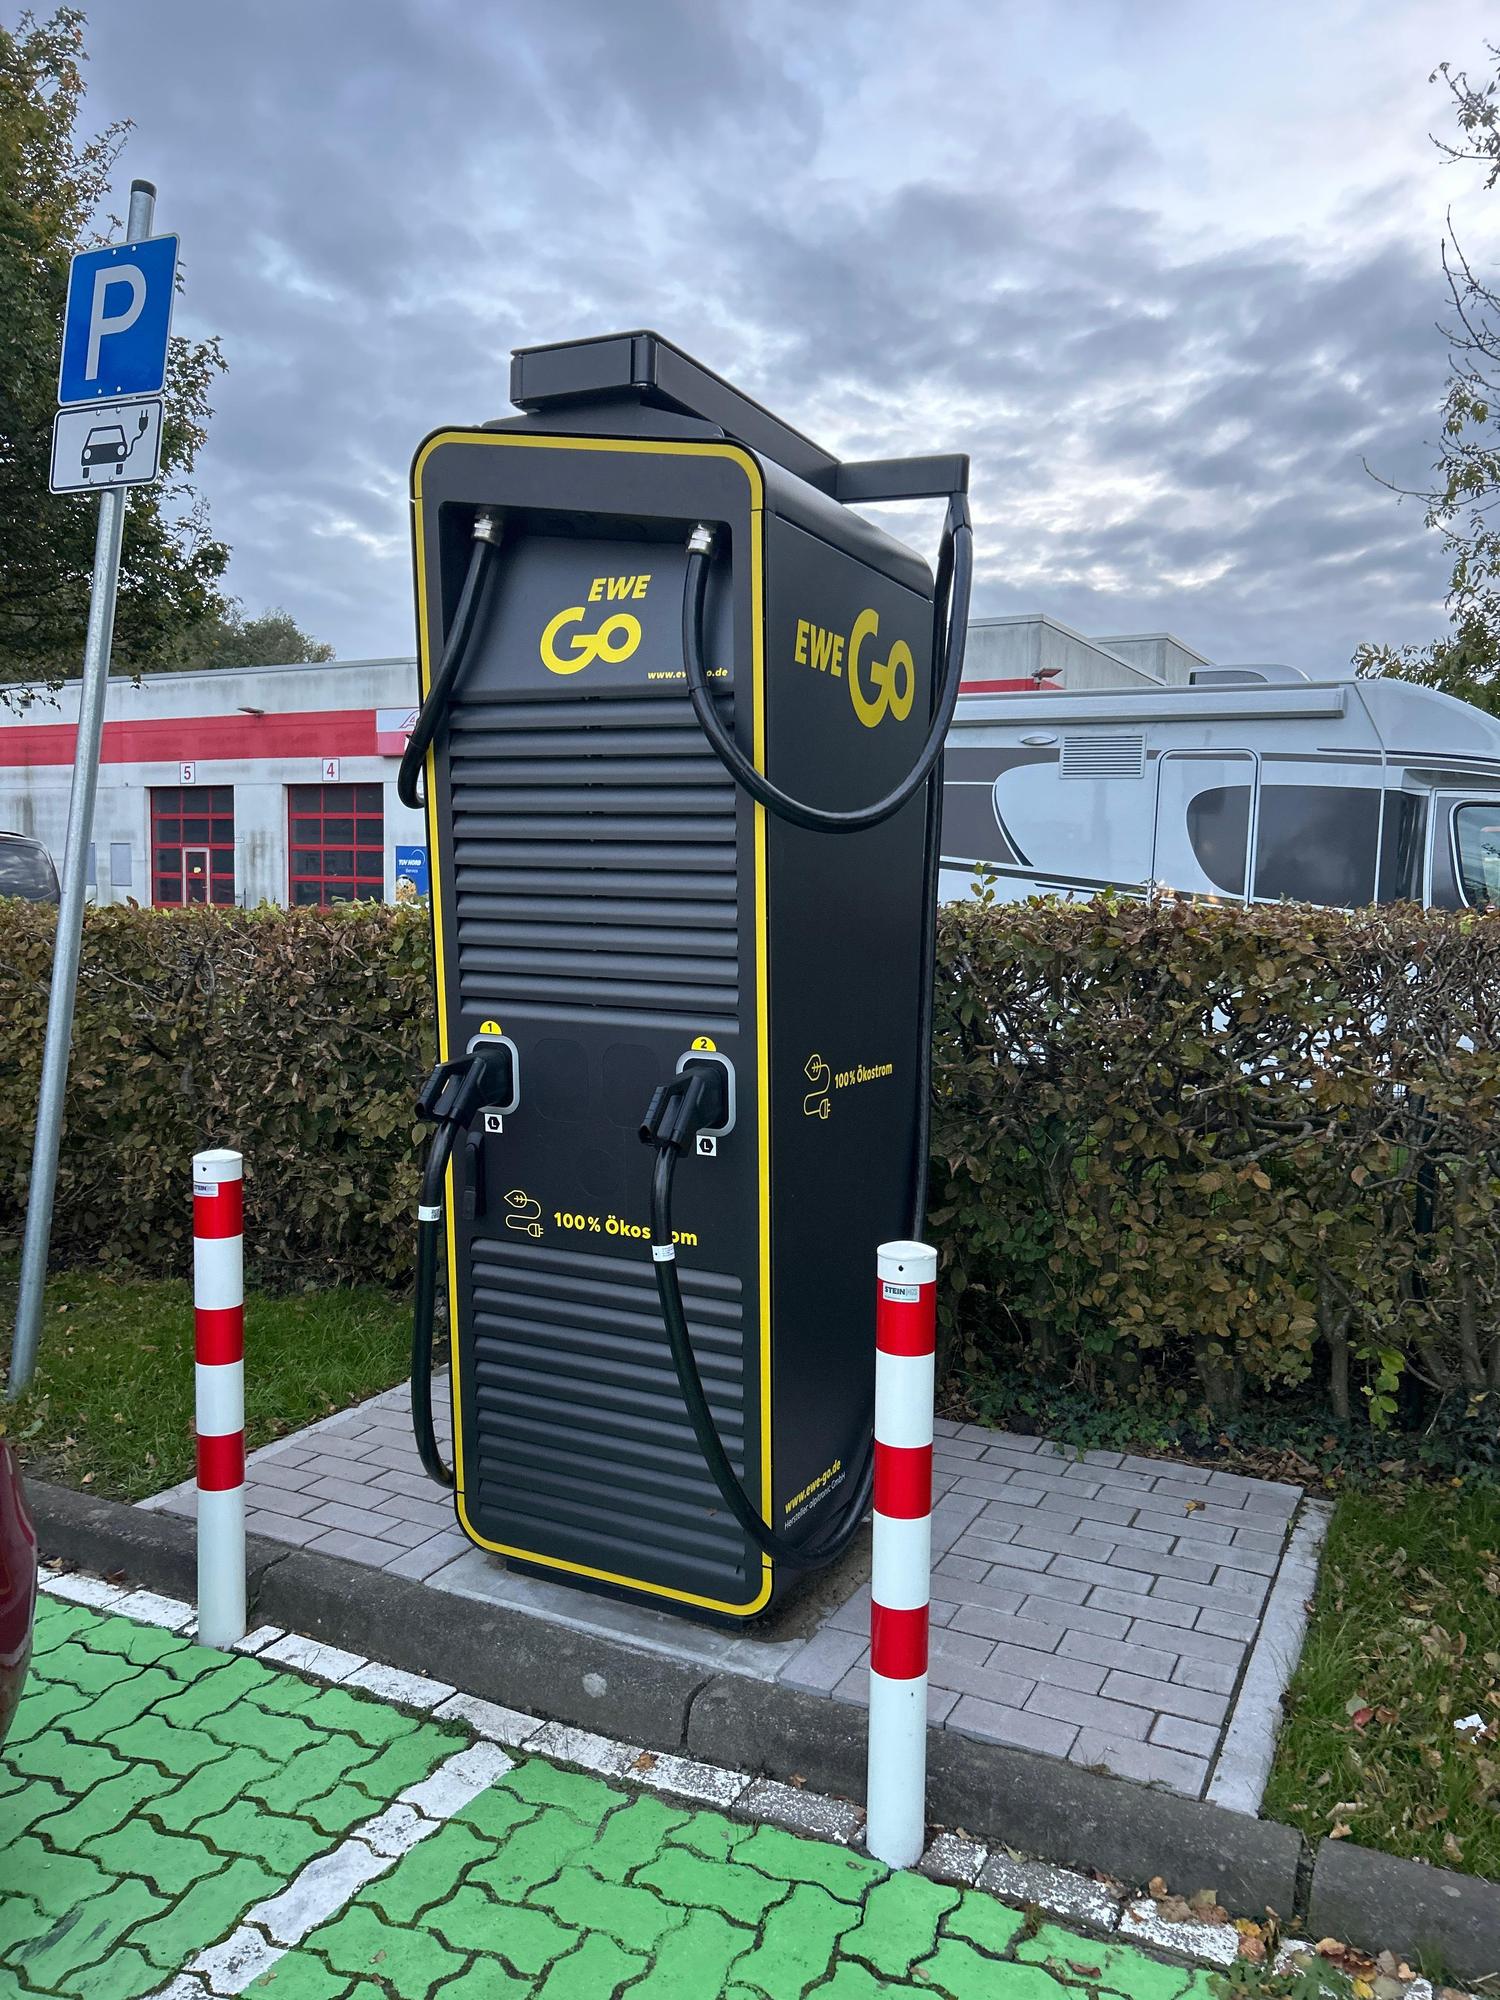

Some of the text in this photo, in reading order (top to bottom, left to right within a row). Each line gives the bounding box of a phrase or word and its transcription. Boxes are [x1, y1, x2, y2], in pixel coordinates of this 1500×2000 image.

[84, 264, 147, 381] P
[587, 574, 651, 602] EWE
[540, 606, 642, 675] Go
[794, 608, 915, 728] EWE Go
[184, 765, 191, 780] 5
[326, 762, 335, 778] 4
[487, 1022, 492, 1032] 1
[700, 1038, 708, 1049] 2
[856, 1063, 893, 1083] Ökostrom
[703, 1141, 710, 1150] L
[604, 1214, 698, 1246] Ökosom
[784, 1459, 841, 1514] www.ewe-go.de
